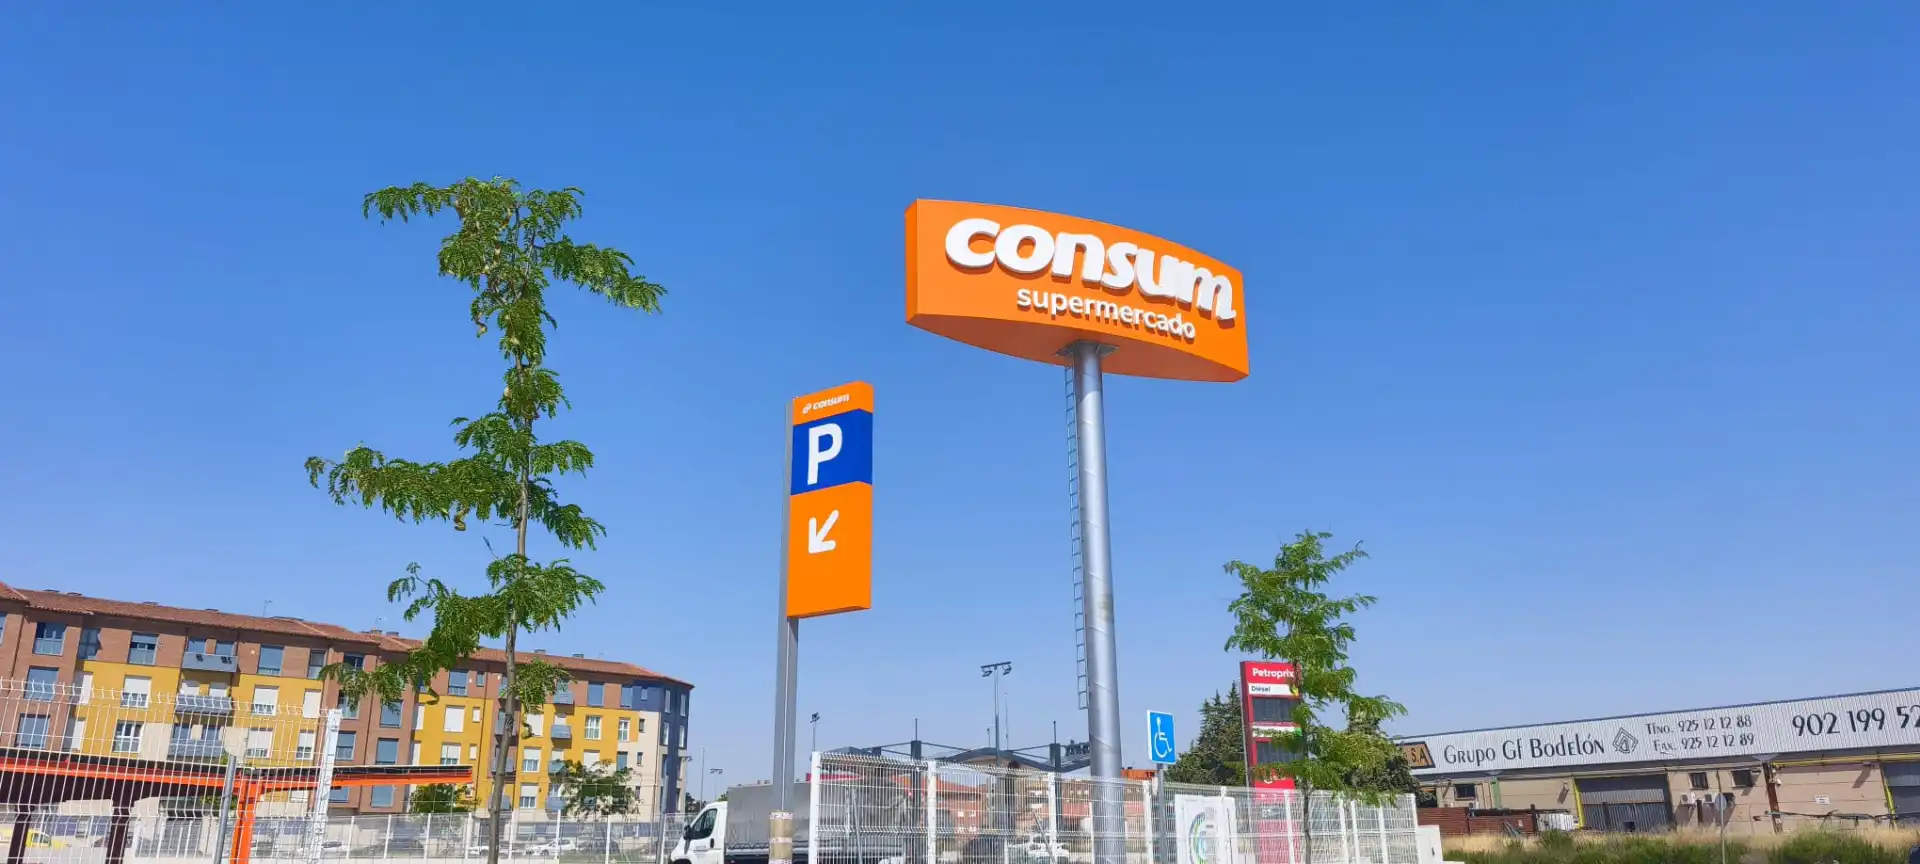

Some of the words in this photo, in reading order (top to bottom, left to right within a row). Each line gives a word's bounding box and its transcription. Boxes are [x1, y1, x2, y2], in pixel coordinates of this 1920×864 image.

[945, 218, 1236, 320] consum
[1017, 288, 1195, 340] supermercado
[813, 394, 850, 410] consum
[807, 423, 843, 485] P
[1252, 667, 1294, 679] Petroprix
[1678, 720, 1699, 732] 925
[1703, 718, 1716, 730] 12
[1720, 716, 1732, 729] 12
[1736, 715, 1752, 728] 88
[1792, 712, 1840, 736] 902
[1847, 708, 1885, 732] 199
[1681, 737, 1702, 749] 925
[1706, 736, 1719, 748] 12
[1722, 735, 1735, 747] 12
[1740, 733, 1754, 746] 89
